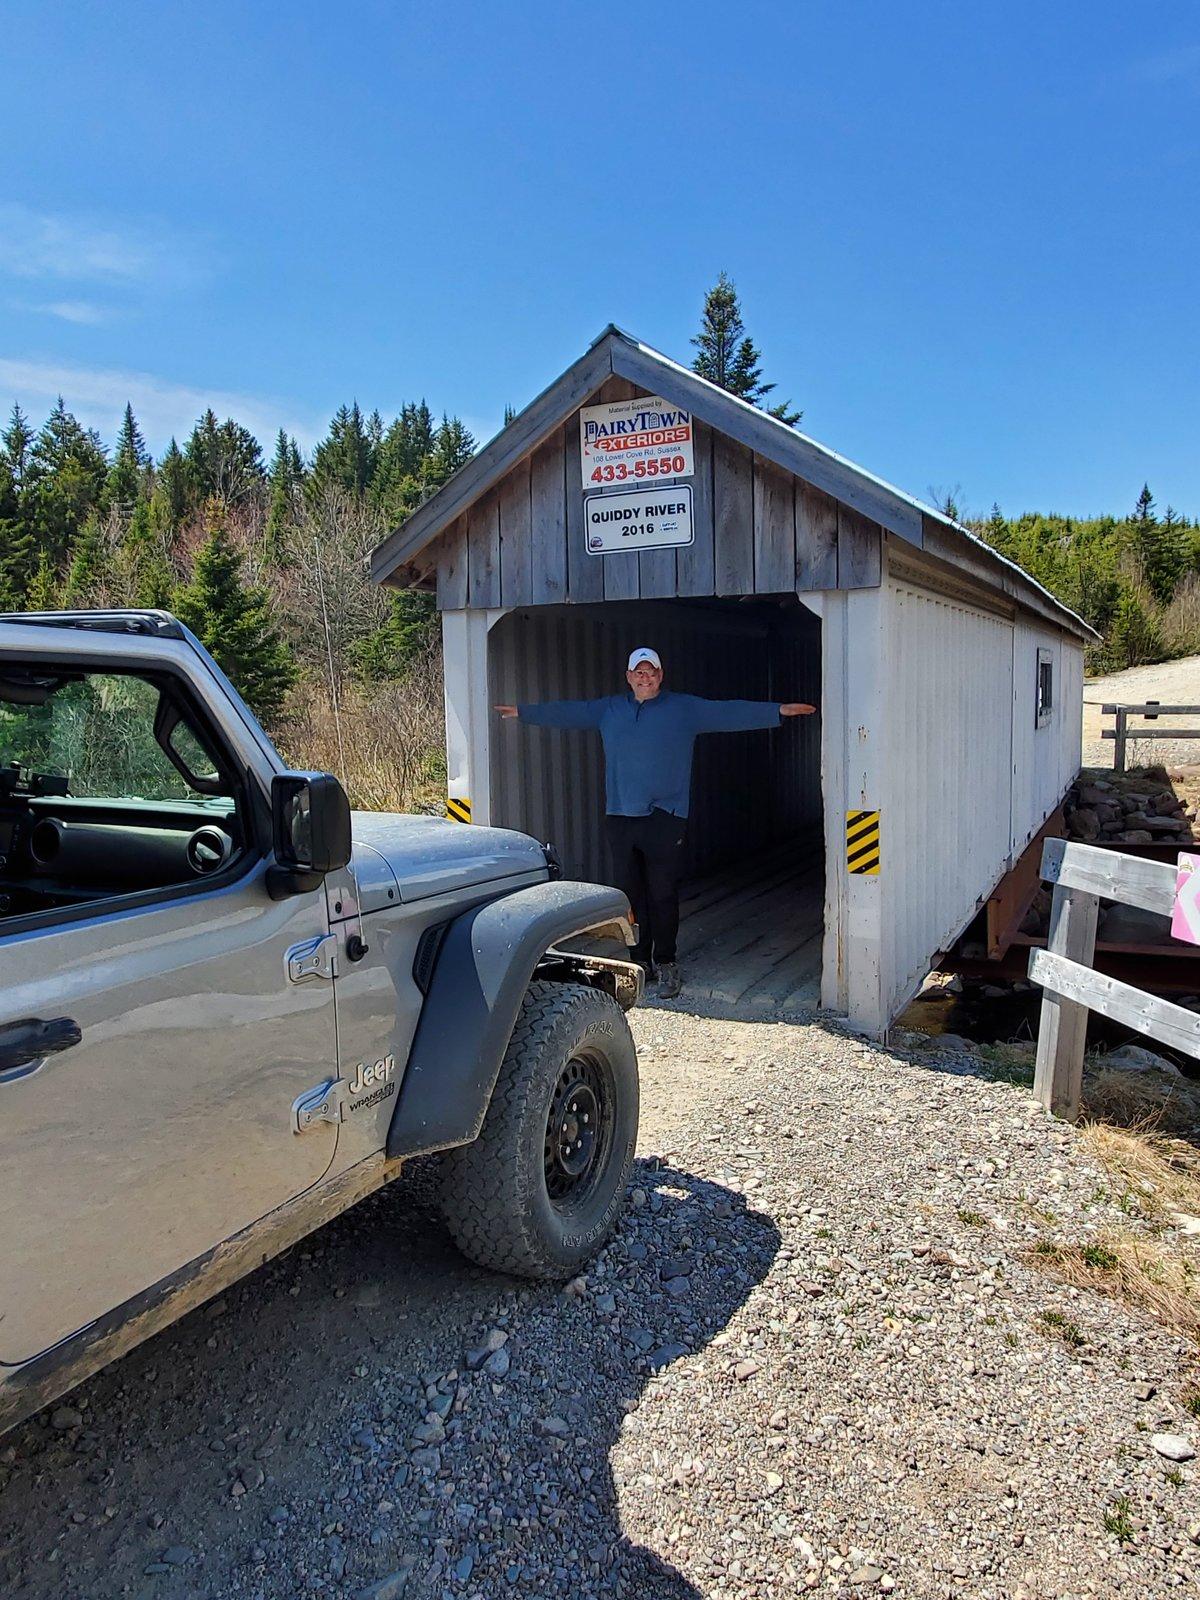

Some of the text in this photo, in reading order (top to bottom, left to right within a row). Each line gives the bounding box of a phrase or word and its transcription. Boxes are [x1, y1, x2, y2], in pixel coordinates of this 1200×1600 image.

[608, 405, 631, 414] Material
[654, 401, 662, 409] by
[598, 429, 687, 450] EXTERIORS
[593, 455, 604, 463] 108
[605, 453, 624, 462] Lower
[626, 451, 643, 459] Cove
[657, 446, 681, 454] Sussex
[591, 455, 685, 483] 433-5550
[591, 503, 686, 524] QUIDDY RIVER
[621, 523, 654, 537] 2016
[349, 1053, 395, 1094] Jeep
[349, 1081, 395, 1112] WRANGLER
